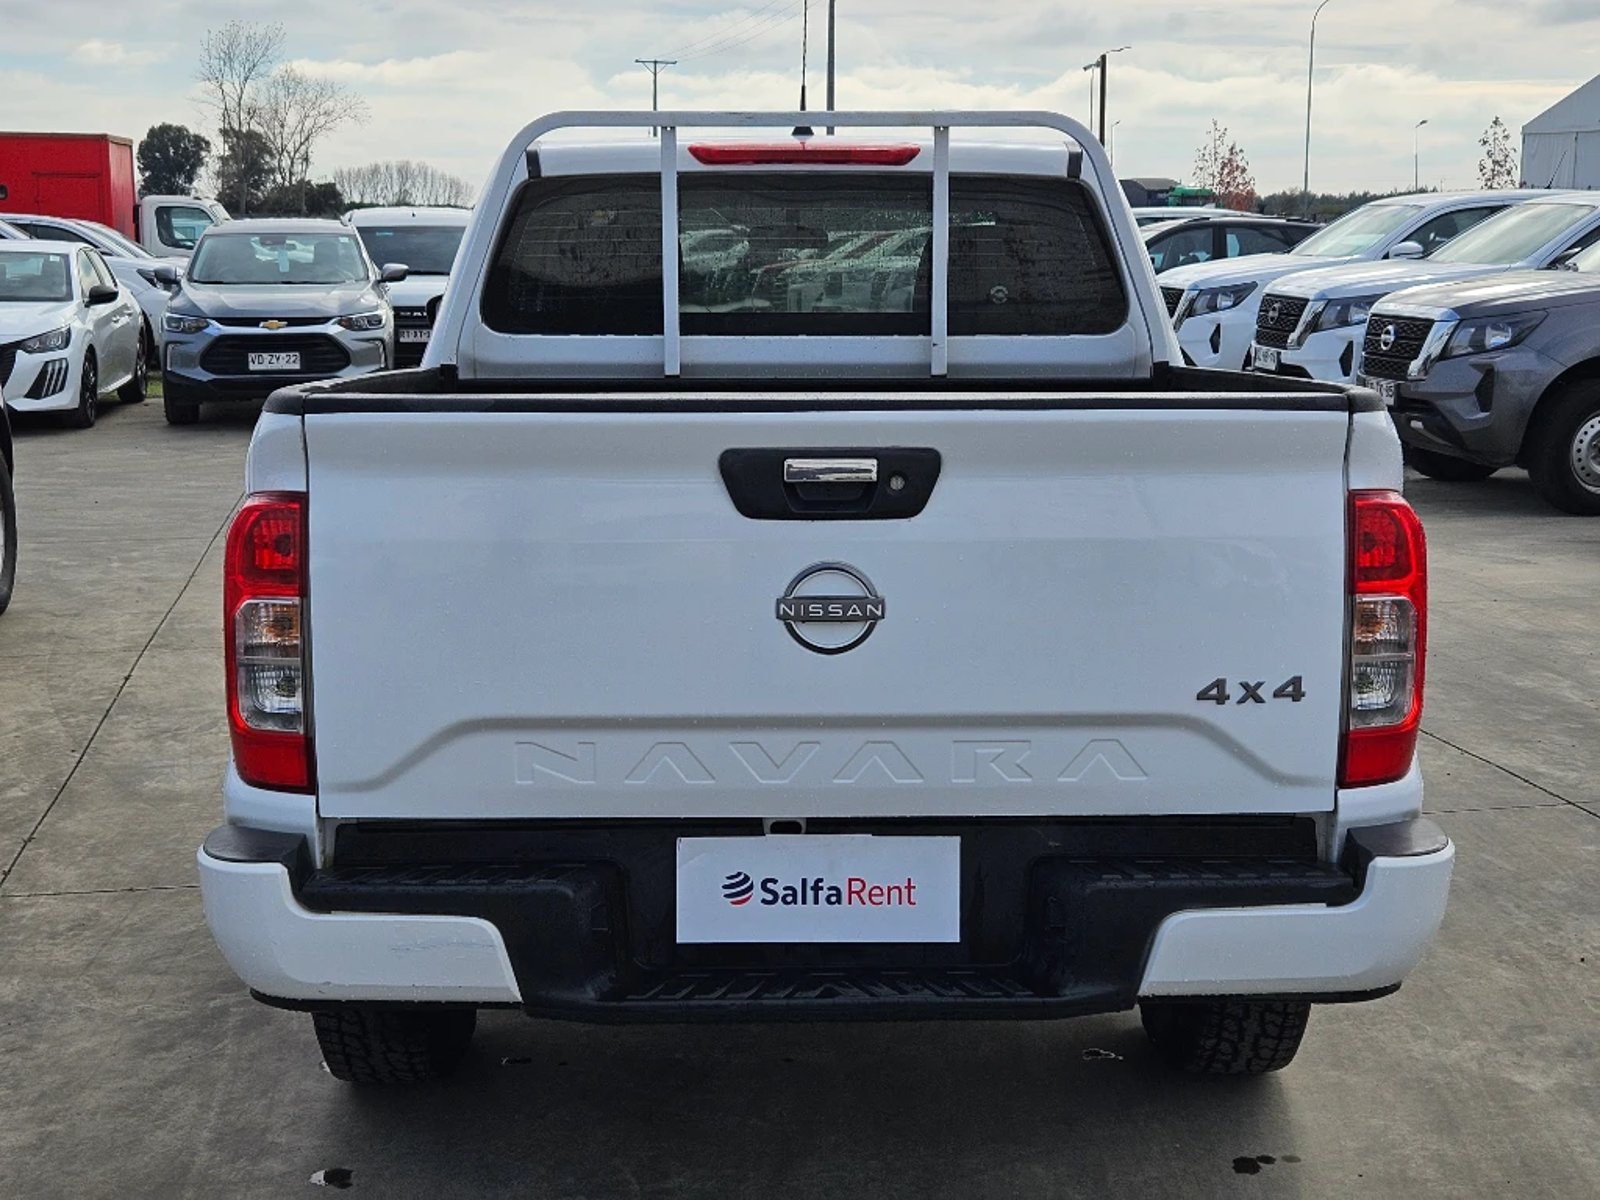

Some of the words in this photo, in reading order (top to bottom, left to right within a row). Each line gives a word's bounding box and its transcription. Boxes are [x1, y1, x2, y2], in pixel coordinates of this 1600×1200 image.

[779, 603, 882, 617] NISSAN
[1196, 675, 1306, 705] 4x4
[514, 738, 1149, 785] NAVARA
